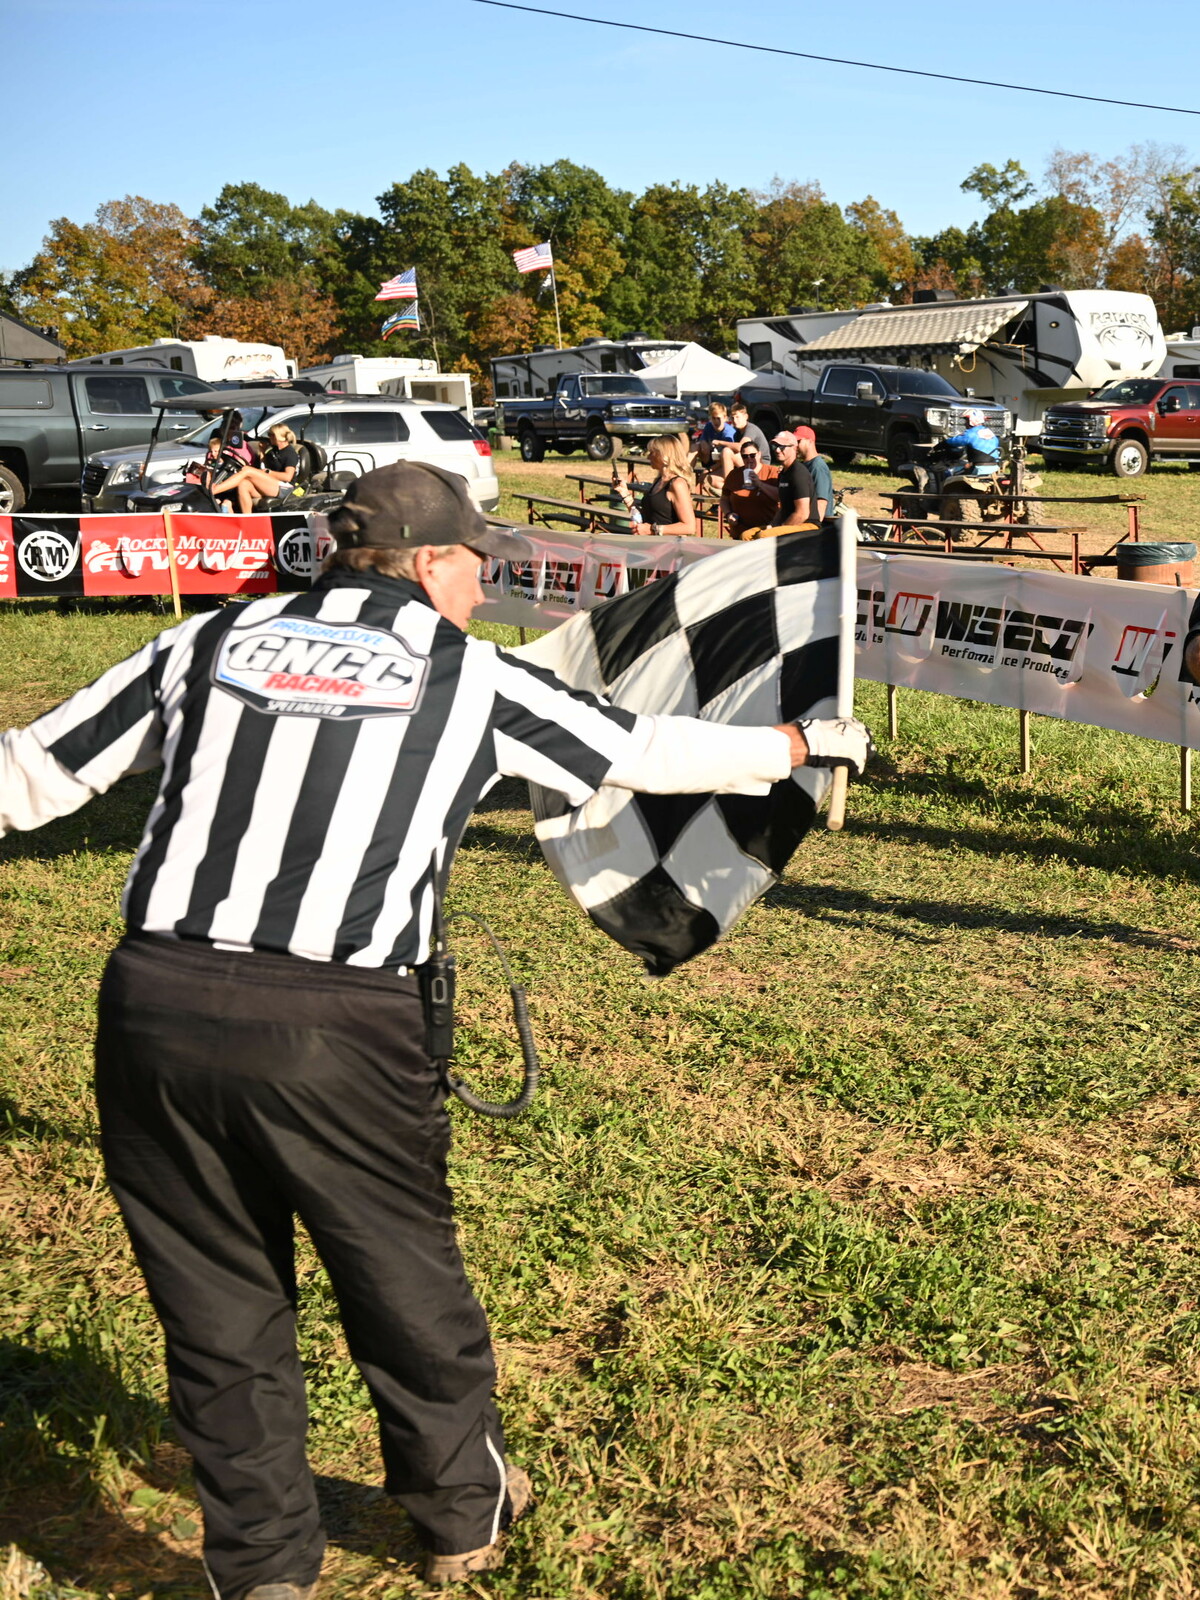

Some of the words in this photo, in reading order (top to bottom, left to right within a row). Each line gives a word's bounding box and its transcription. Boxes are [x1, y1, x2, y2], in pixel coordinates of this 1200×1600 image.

[176, 536, 271, 551] MOUNTAIN
[235, 570, 270, 579] .com
[269, 620, 385, 646] PROGRESSIVE
[227, 634, 416, 691] GNCC
[263, 673, 366, 698] RACING
